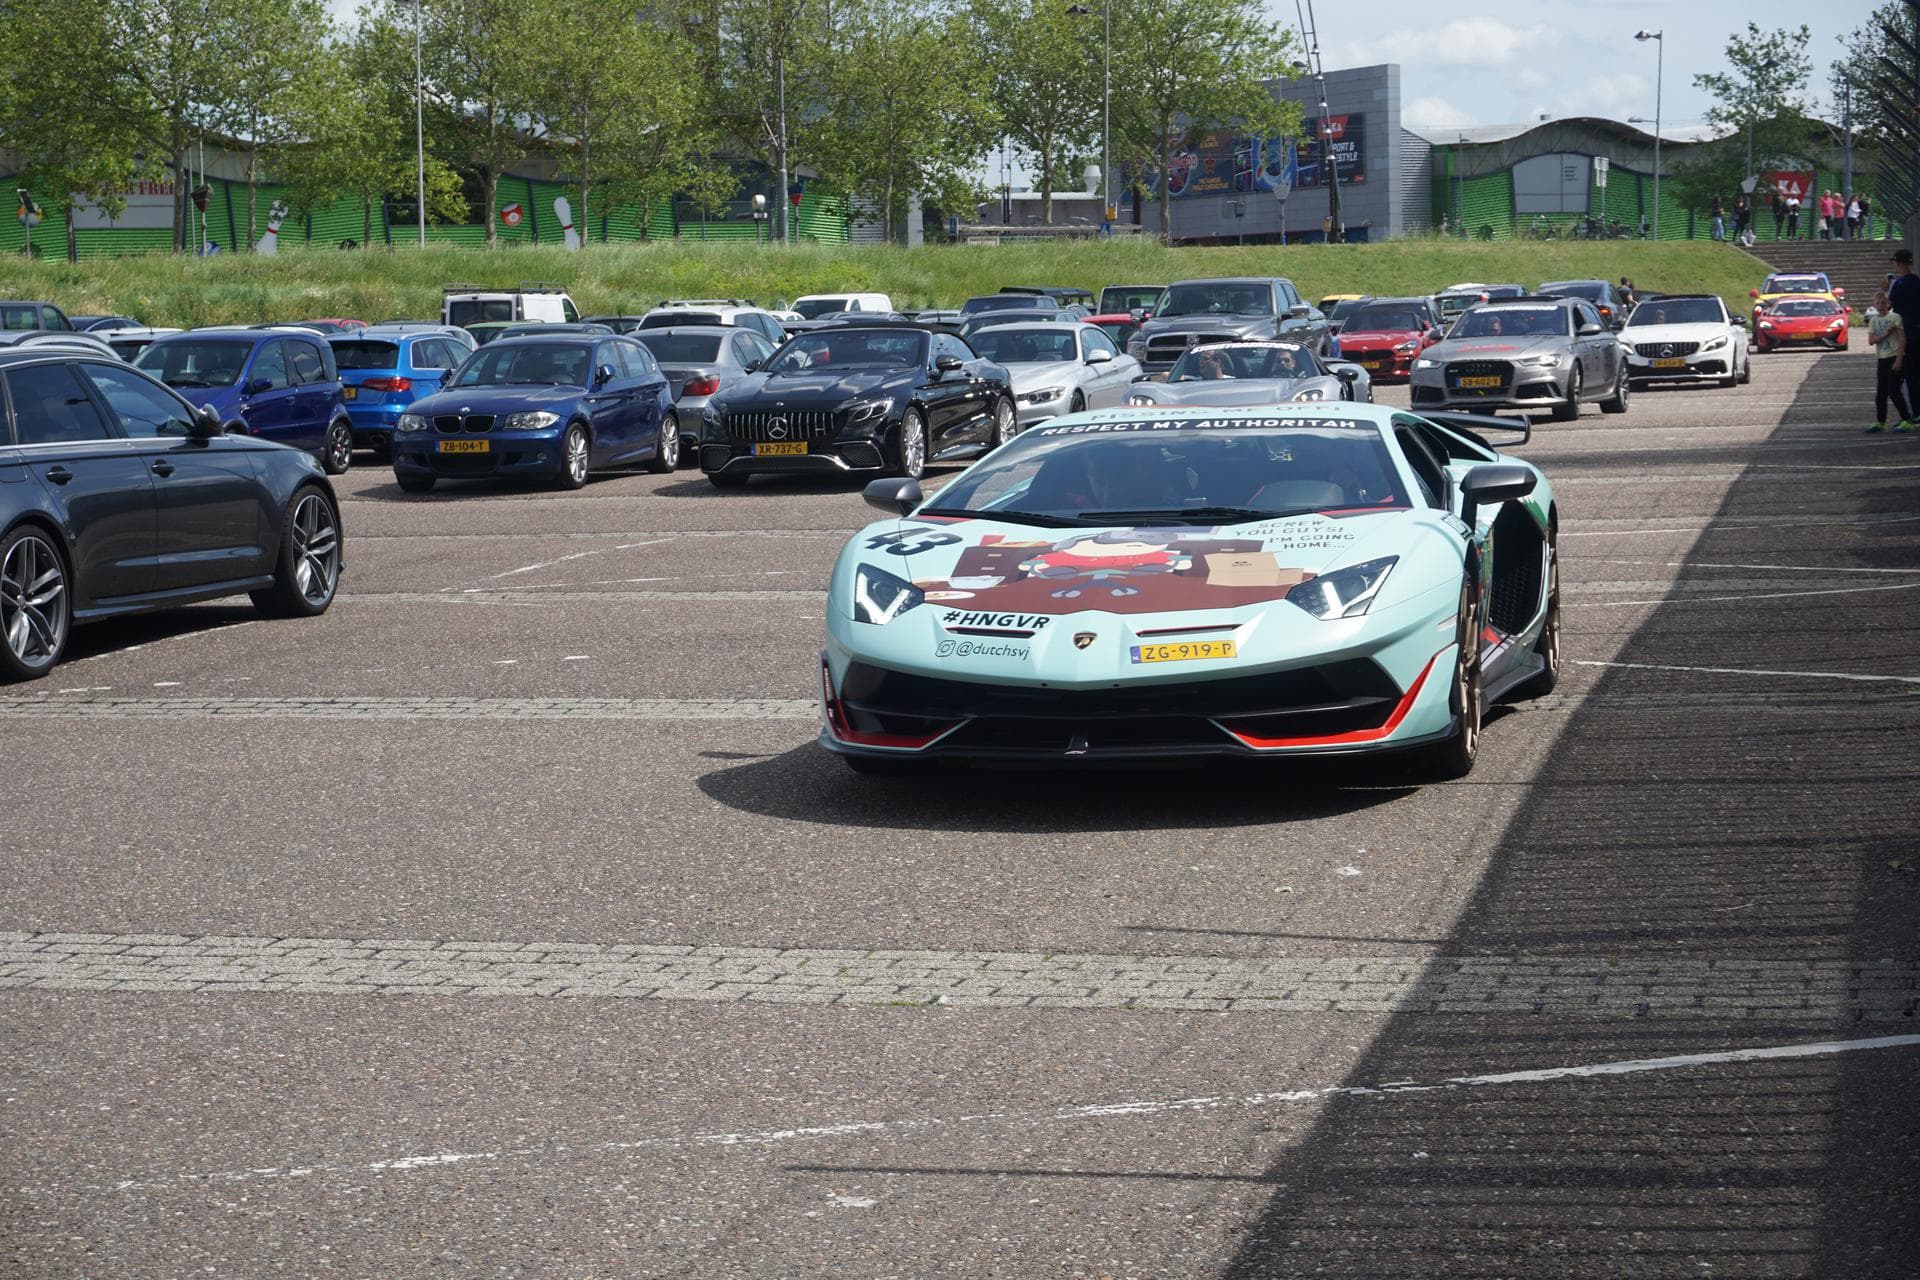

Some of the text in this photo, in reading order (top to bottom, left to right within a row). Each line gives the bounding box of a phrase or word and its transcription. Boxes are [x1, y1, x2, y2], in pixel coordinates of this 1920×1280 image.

[1091, 409, 1208, 420] PISSING
[1040, 419, 1356, 436] RESPECT MY AUTHORITAH
[443, 441, 485, 452] ZB-104-T
[759, 444, 802, 454] XR-737-G
[1259, 520, 1325, 528] SCREW
[1234, 526, 1345, 536] YOU GUYS!
[863, 527, 964, 556] 43
[1300, 533, 1355, 541] GOING
[942, 610, 1051, 629] #HNGVR
[956, 641, 1031, 661] @dutchsvj
[1144, 643, 1232, 660] ZG-919-P
